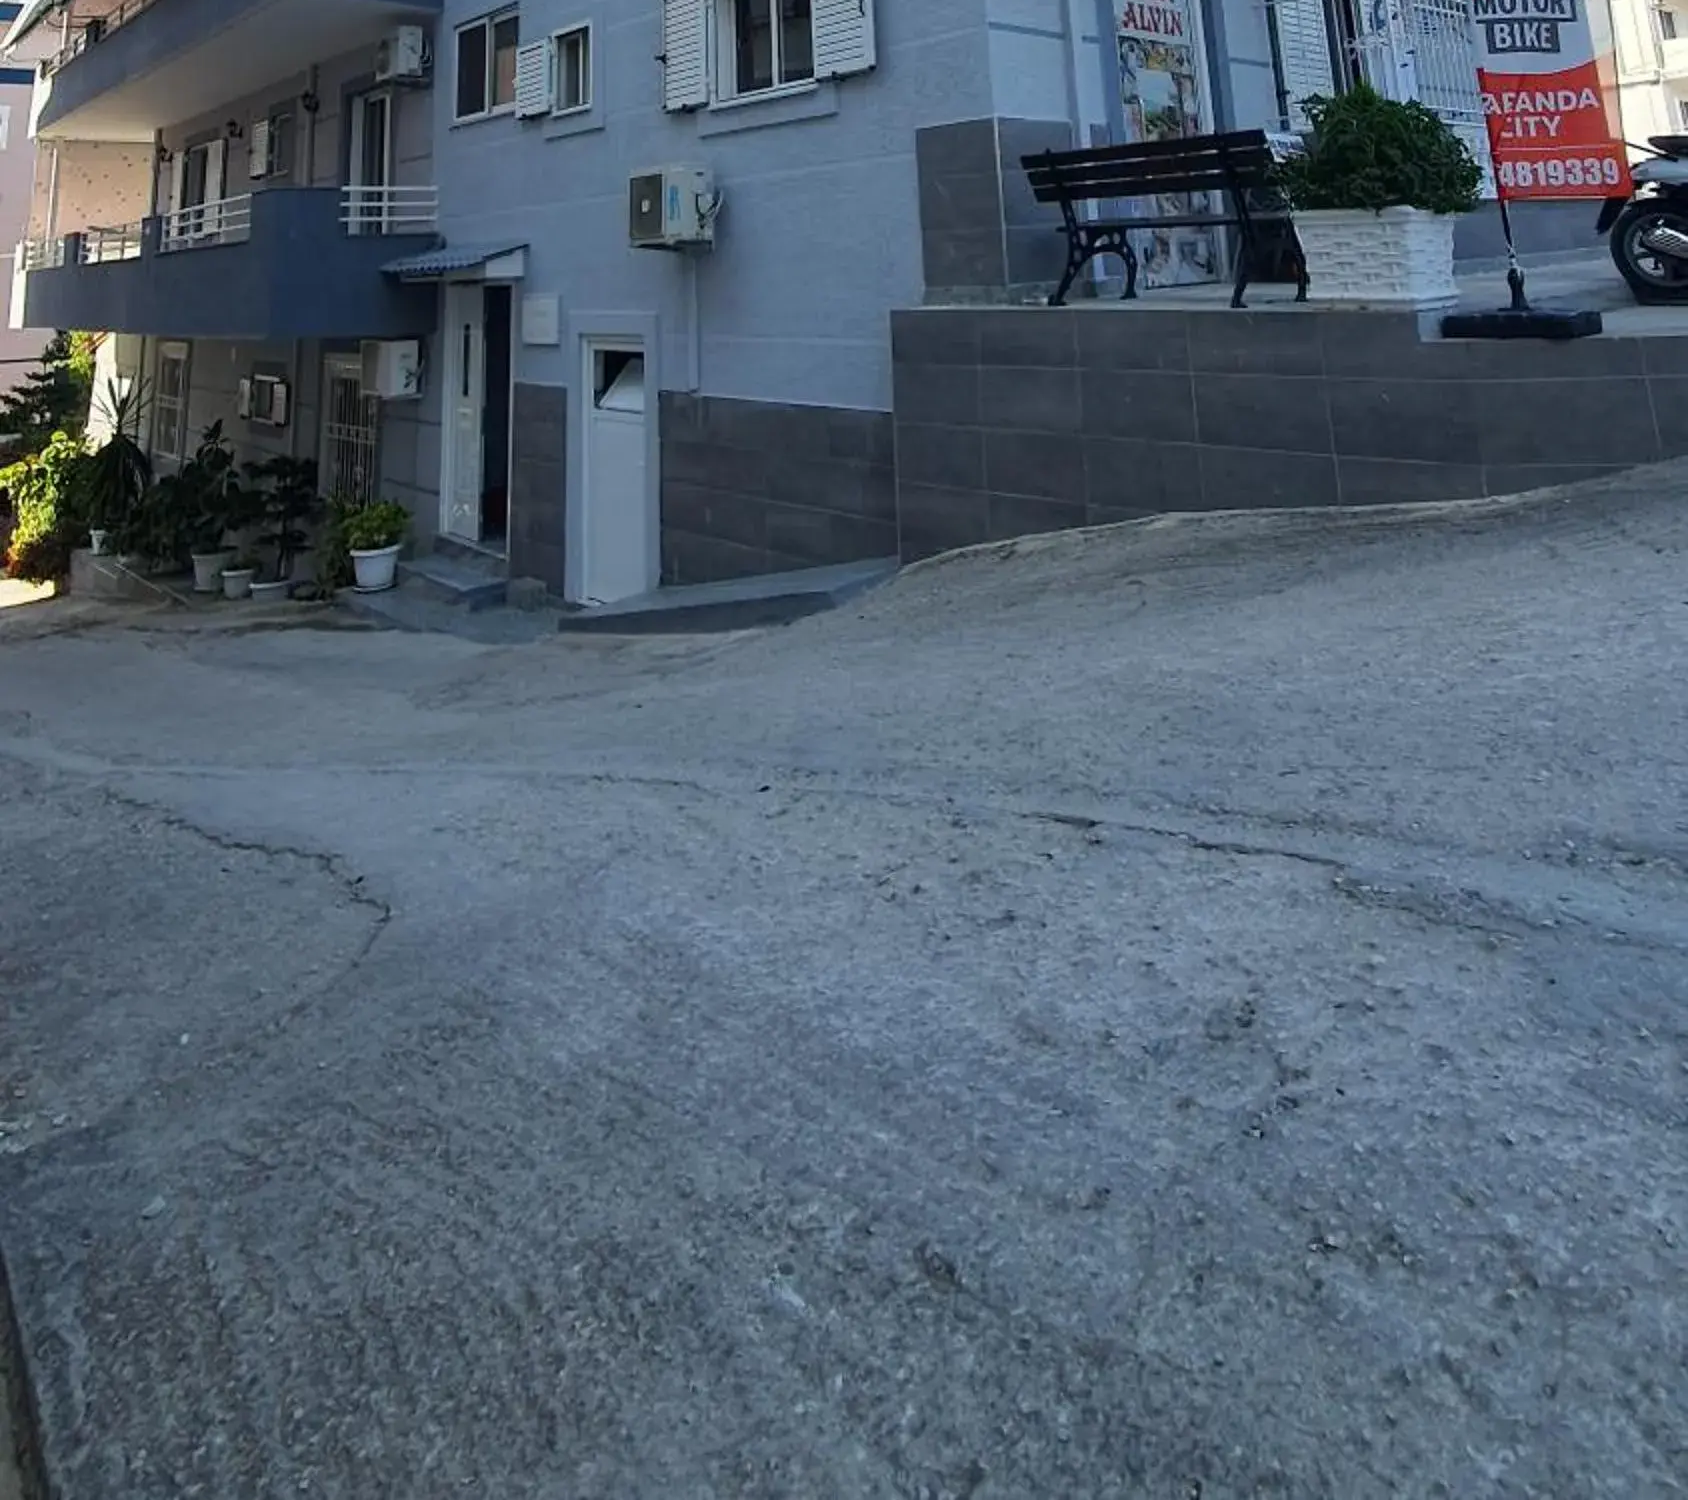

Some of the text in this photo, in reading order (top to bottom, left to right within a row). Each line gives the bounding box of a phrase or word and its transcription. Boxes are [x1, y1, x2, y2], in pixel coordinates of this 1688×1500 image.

[1122, 2, 1183, 37] ALVIN
[1493, 22, 1552, 49] BIKE
[1481, 87, 1599, 115] AANDA
